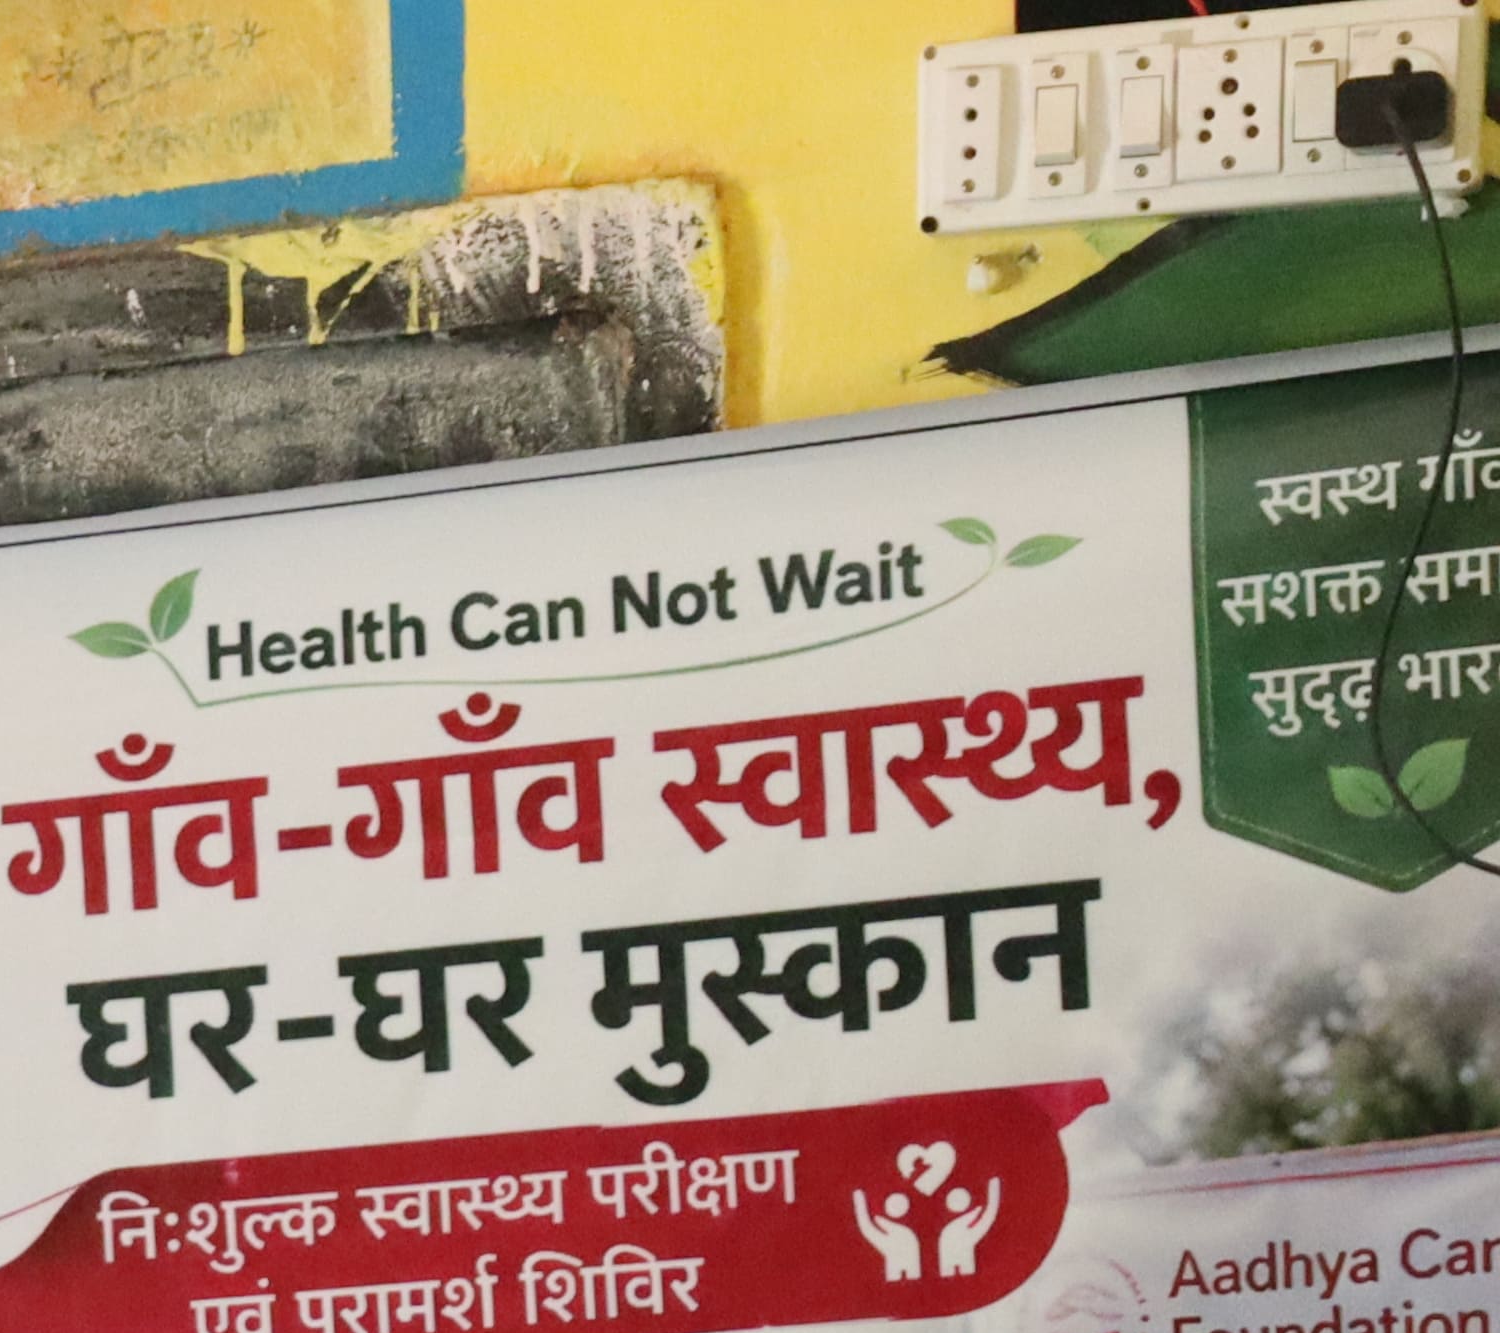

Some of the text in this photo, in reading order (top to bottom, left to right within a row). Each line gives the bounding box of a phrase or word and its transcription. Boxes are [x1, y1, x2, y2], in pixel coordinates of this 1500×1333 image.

[1255, 461, 1403, 526] स्वस्थ
[208, 542, 923, 680] Health Can Not Wait
[1217, 560, 1386, 628] सशक्त
[1398, 644, 1500, 701] भार
[1, 676, 1181, 915] गाँव-गाँव स्वास्थ्य,
[66, 878, 1101, 1106] घर-घर मुस्कान
[97, 1141, 799, 1273] निःशुल्क स्वास्थ्य परीक्षण
[519, 1245, 704, 1324] शिविर
[1168, 1228, 1500, 1300] Aadhya Car
